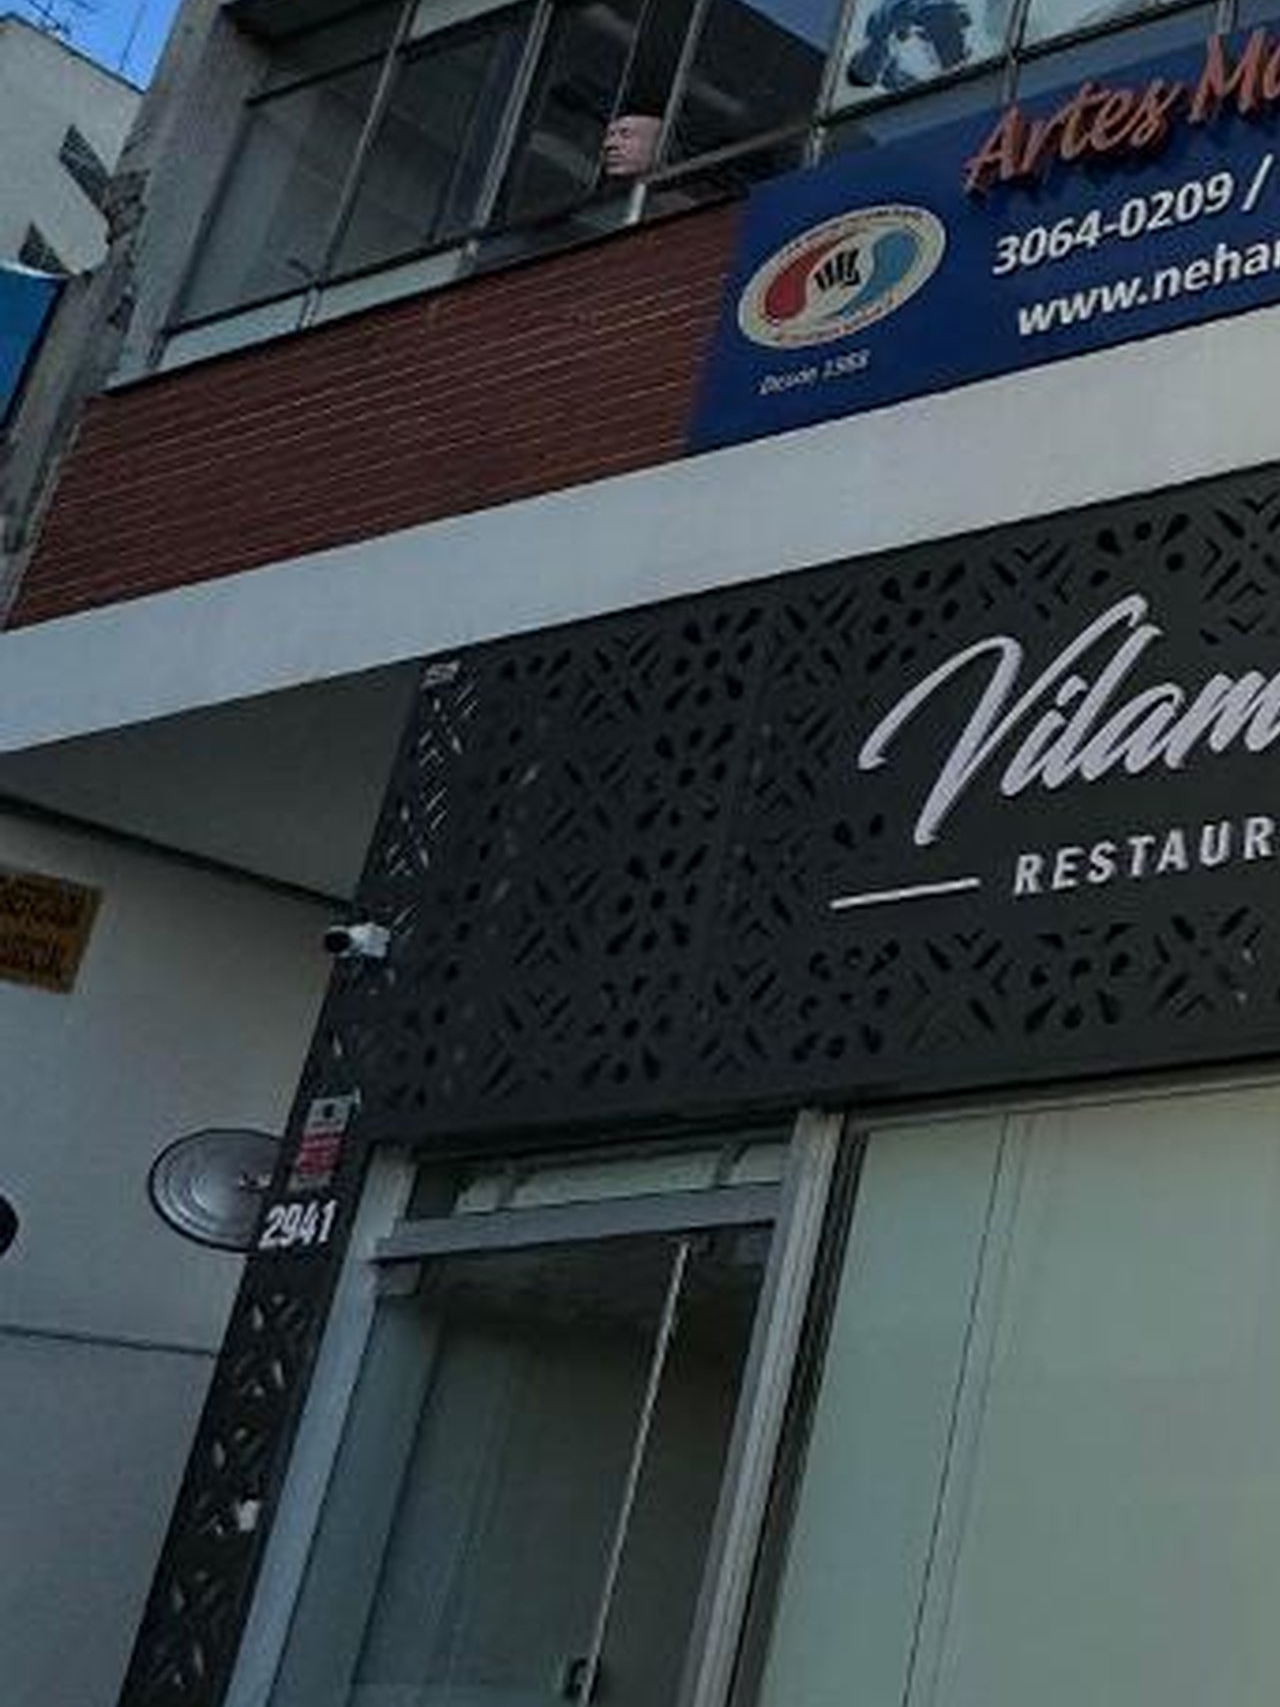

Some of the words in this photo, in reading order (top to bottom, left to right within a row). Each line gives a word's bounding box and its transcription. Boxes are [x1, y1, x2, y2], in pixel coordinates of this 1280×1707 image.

[962, 69, 1180, 193] Artes
[993, 172, 1232, 276] 3064-0209
[1241, 152, 1272, 212] /
[258, 1199, 337, 1250] 2941
